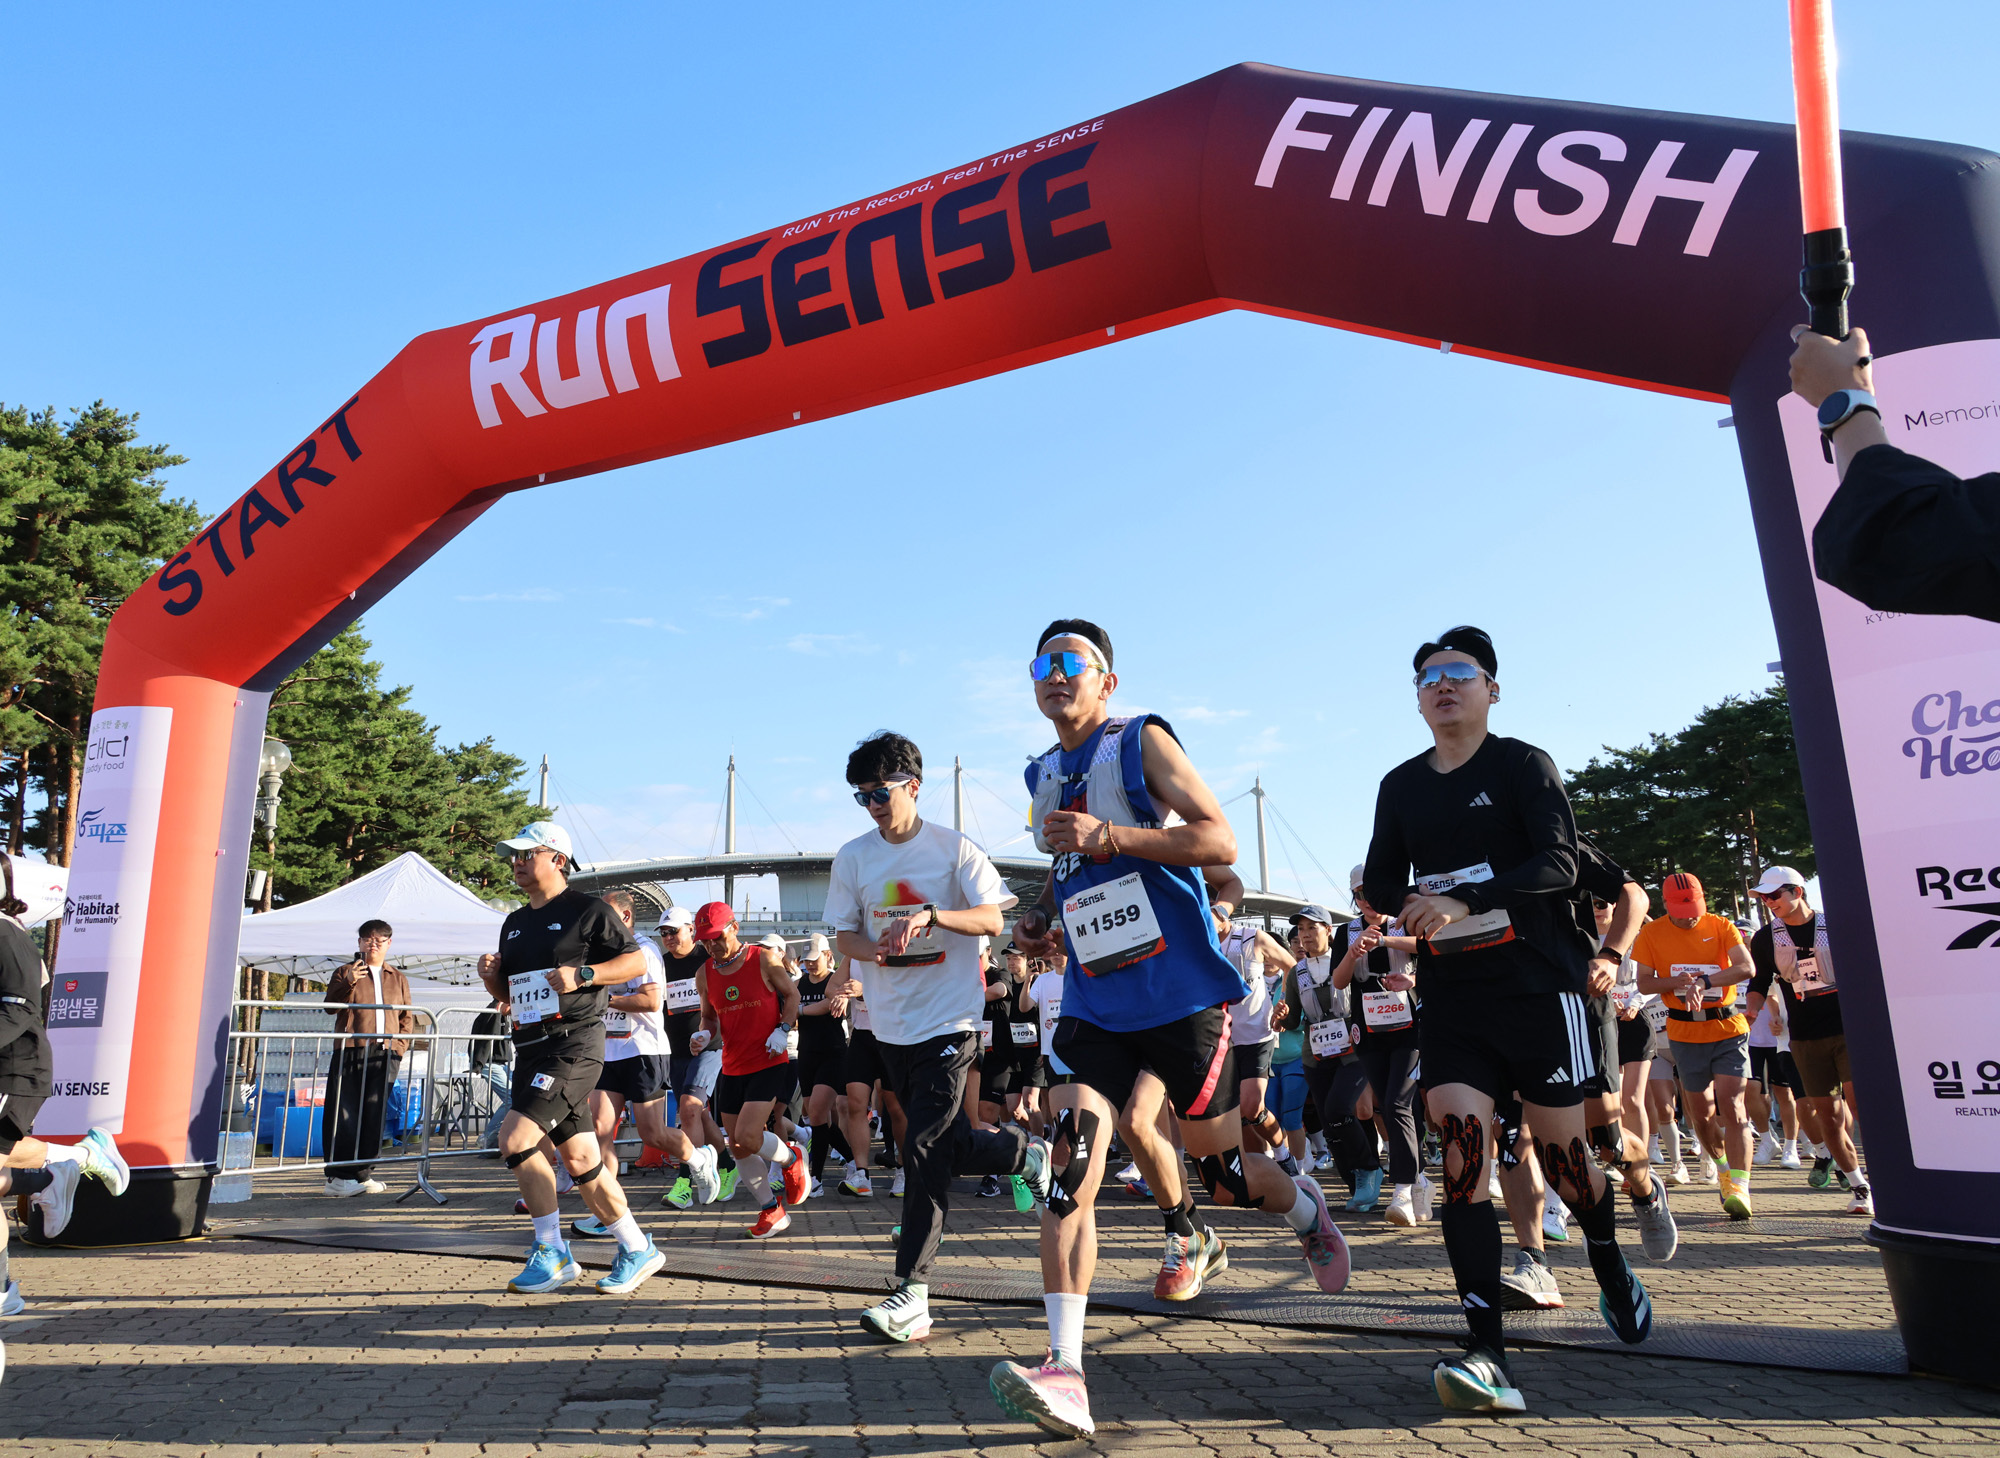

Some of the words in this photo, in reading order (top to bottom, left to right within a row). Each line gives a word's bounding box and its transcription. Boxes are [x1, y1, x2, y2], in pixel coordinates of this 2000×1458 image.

[782, 218, 822, 239] RUN
[828, 206, 861, 223] The
[865, 180, 935, 211] Record,
[942, 162, 984, 184] Feel
[991, 149, 1028, 168] The
[1033, 119, 1105, 153] SENSE
[1254, 97, 1759, 257] FINISH
[1904, 400, 2000, 431] Memori
[158, 395, 363, 616] START
[103, 761, 125, 771] food
[1469, 867, 1488, 876] 10km
[1118, 877, 1138, 887] 10km
[76, 902, 120, 916] Habitat
[873, 910, 888, 918] Run
[75, 917, 83, 925] for
[84, 916, 119, 925] Humanity
[1076, 924, 1088, 938] M
[1090, 904, 1141, 935] 1559
[517, 988, 551, 1004] 1113
[677, 989, 699, 998] 1103
[50, 998, 98, 1021] 동원샘물
[1377, 1003, 1405, 1014] 2266
[1318, 1030, 1343, 1043] 1156
[65, 1082, 110, 1096] SENSE
